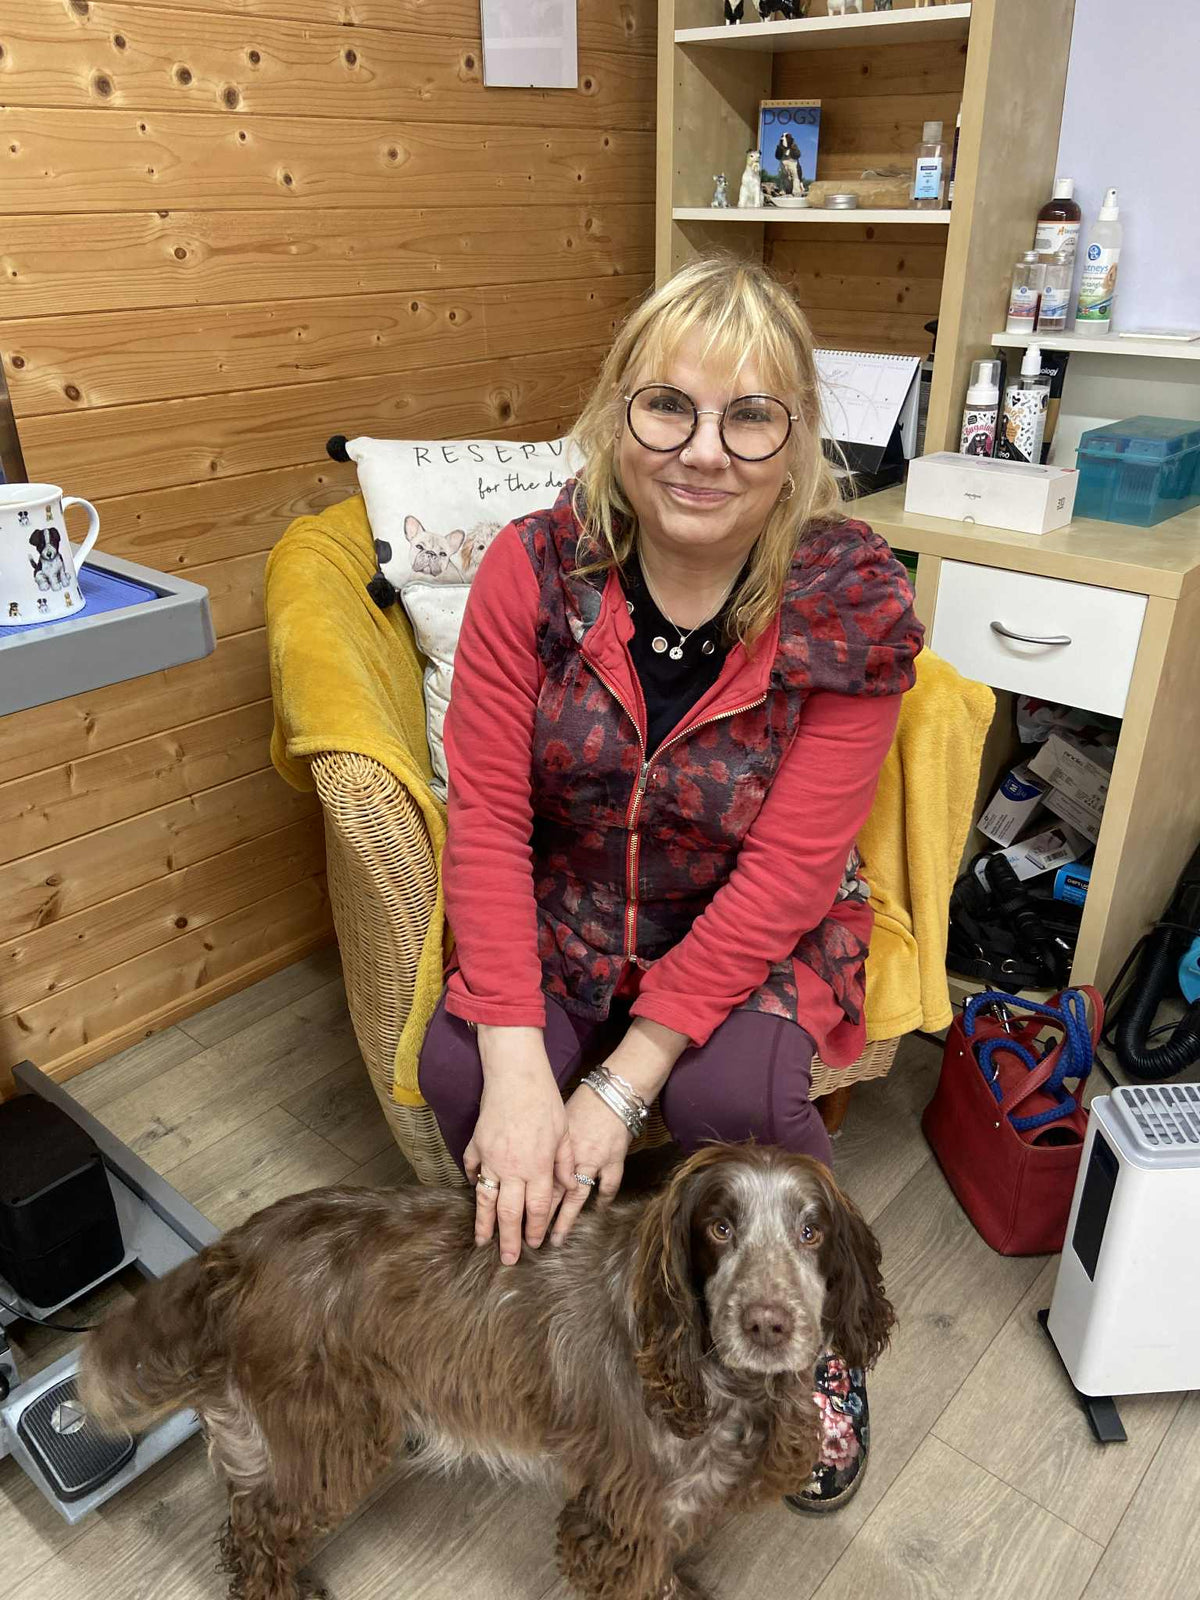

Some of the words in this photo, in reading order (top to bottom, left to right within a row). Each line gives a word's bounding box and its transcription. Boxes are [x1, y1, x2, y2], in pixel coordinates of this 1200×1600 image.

[763, 109, 816, 125] DOGS
[413, 440, 563, 467] RESERV
[478, 478, 500, 500] for
[505, 473, 540, 492] the
[545, 471, 567, 489] do
